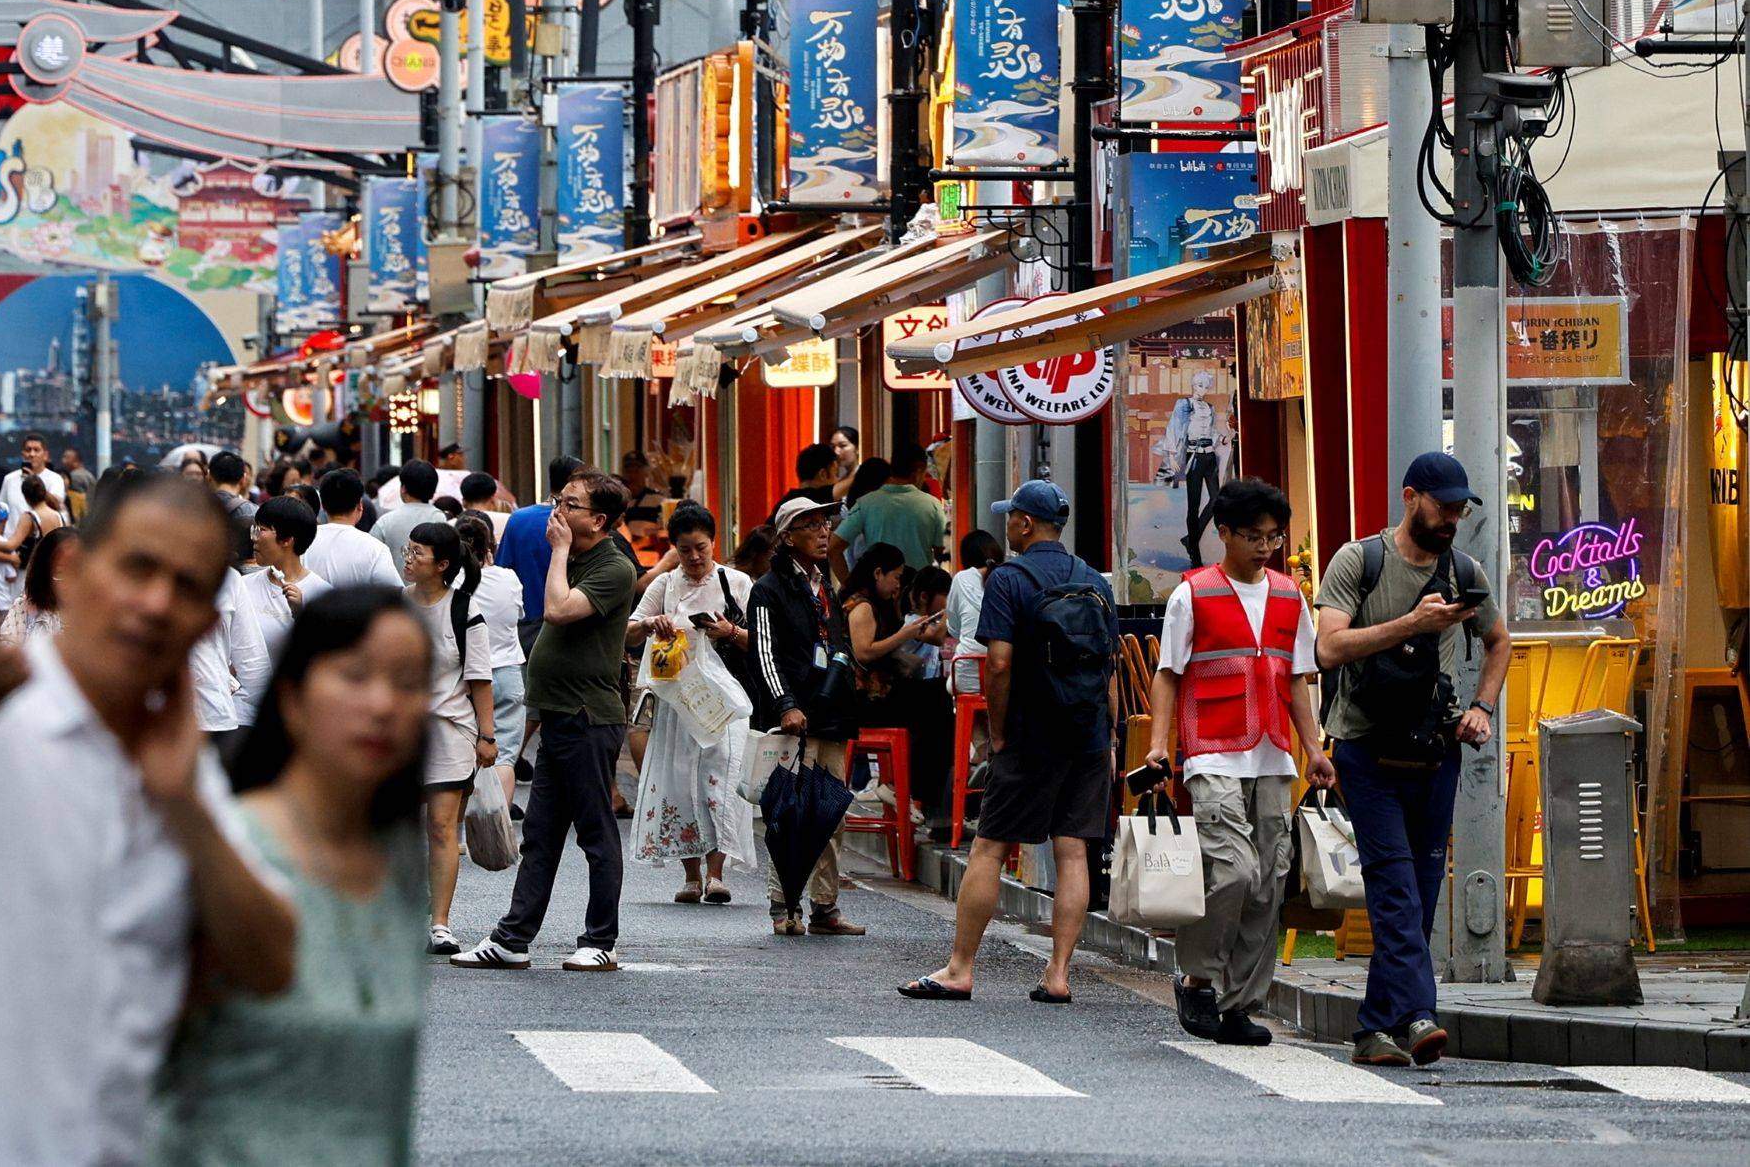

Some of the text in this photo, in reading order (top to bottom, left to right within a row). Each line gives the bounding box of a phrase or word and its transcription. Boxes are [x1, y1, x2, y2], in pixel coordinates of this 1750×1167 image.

[806, 10, 854, 129] 万物有灵
[491, 152, 525, 232] 万物有灵
[569, 124, 607, 214] 万物有灵
[1554, 317, 1600, 327] ICHIBAN
[771, 352, 831, 373] 蝶酥
[1025, 391, 1089, 413] WELFARE
[1089, 345, 1114, 400] LOTTER
[1544, 356, 1571, 366] press
[1531, 518, 1643, 580] Cocktails
[1544, 575, 1647, 617] Dreams
[1587, 567, 1602, 587] &
